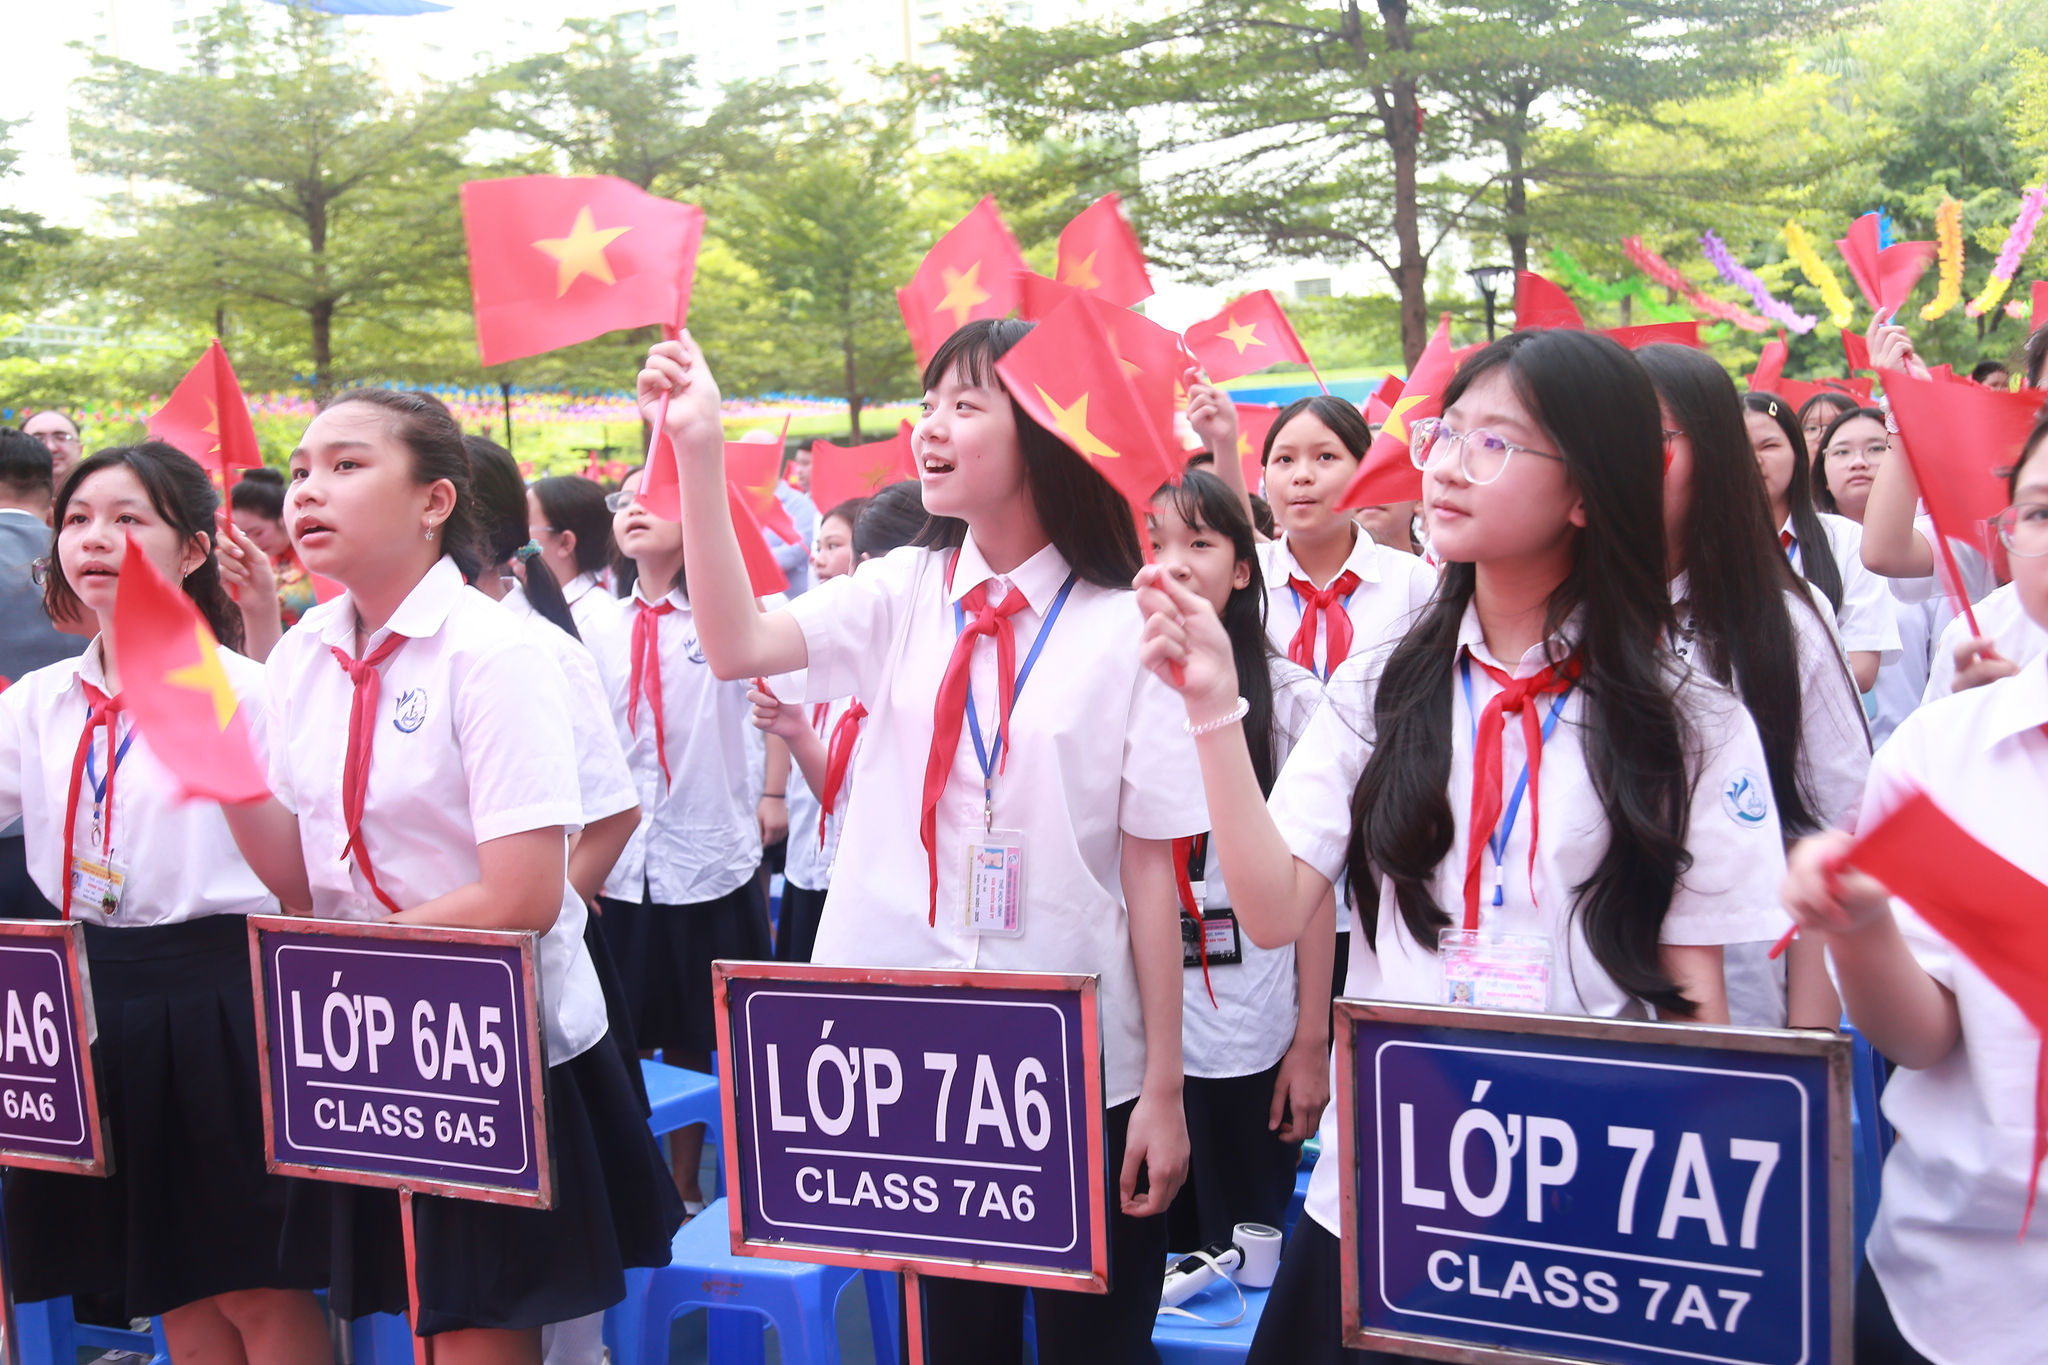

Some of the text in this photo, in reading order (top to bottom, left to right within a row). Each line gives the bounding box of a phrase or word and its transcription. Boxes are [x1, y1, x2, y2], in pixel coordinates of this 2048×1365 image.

[0, 989, 60, 1068] A6
[291, 970, 506, 1088] LỚP 6A5
[3, 1089, 56, 1123] 6A6
[314, 1097, 496, 1148] CLASS 6A5
[766, 1019, 1052, 1152] LỚP 7A6
[795, 1166, 1036, 1222] CLASS 7A6
[1399, 1079, 1779, 1249] LỚP 7A7
[1427, 1249, 1750, 1333] CLASS 7A7
